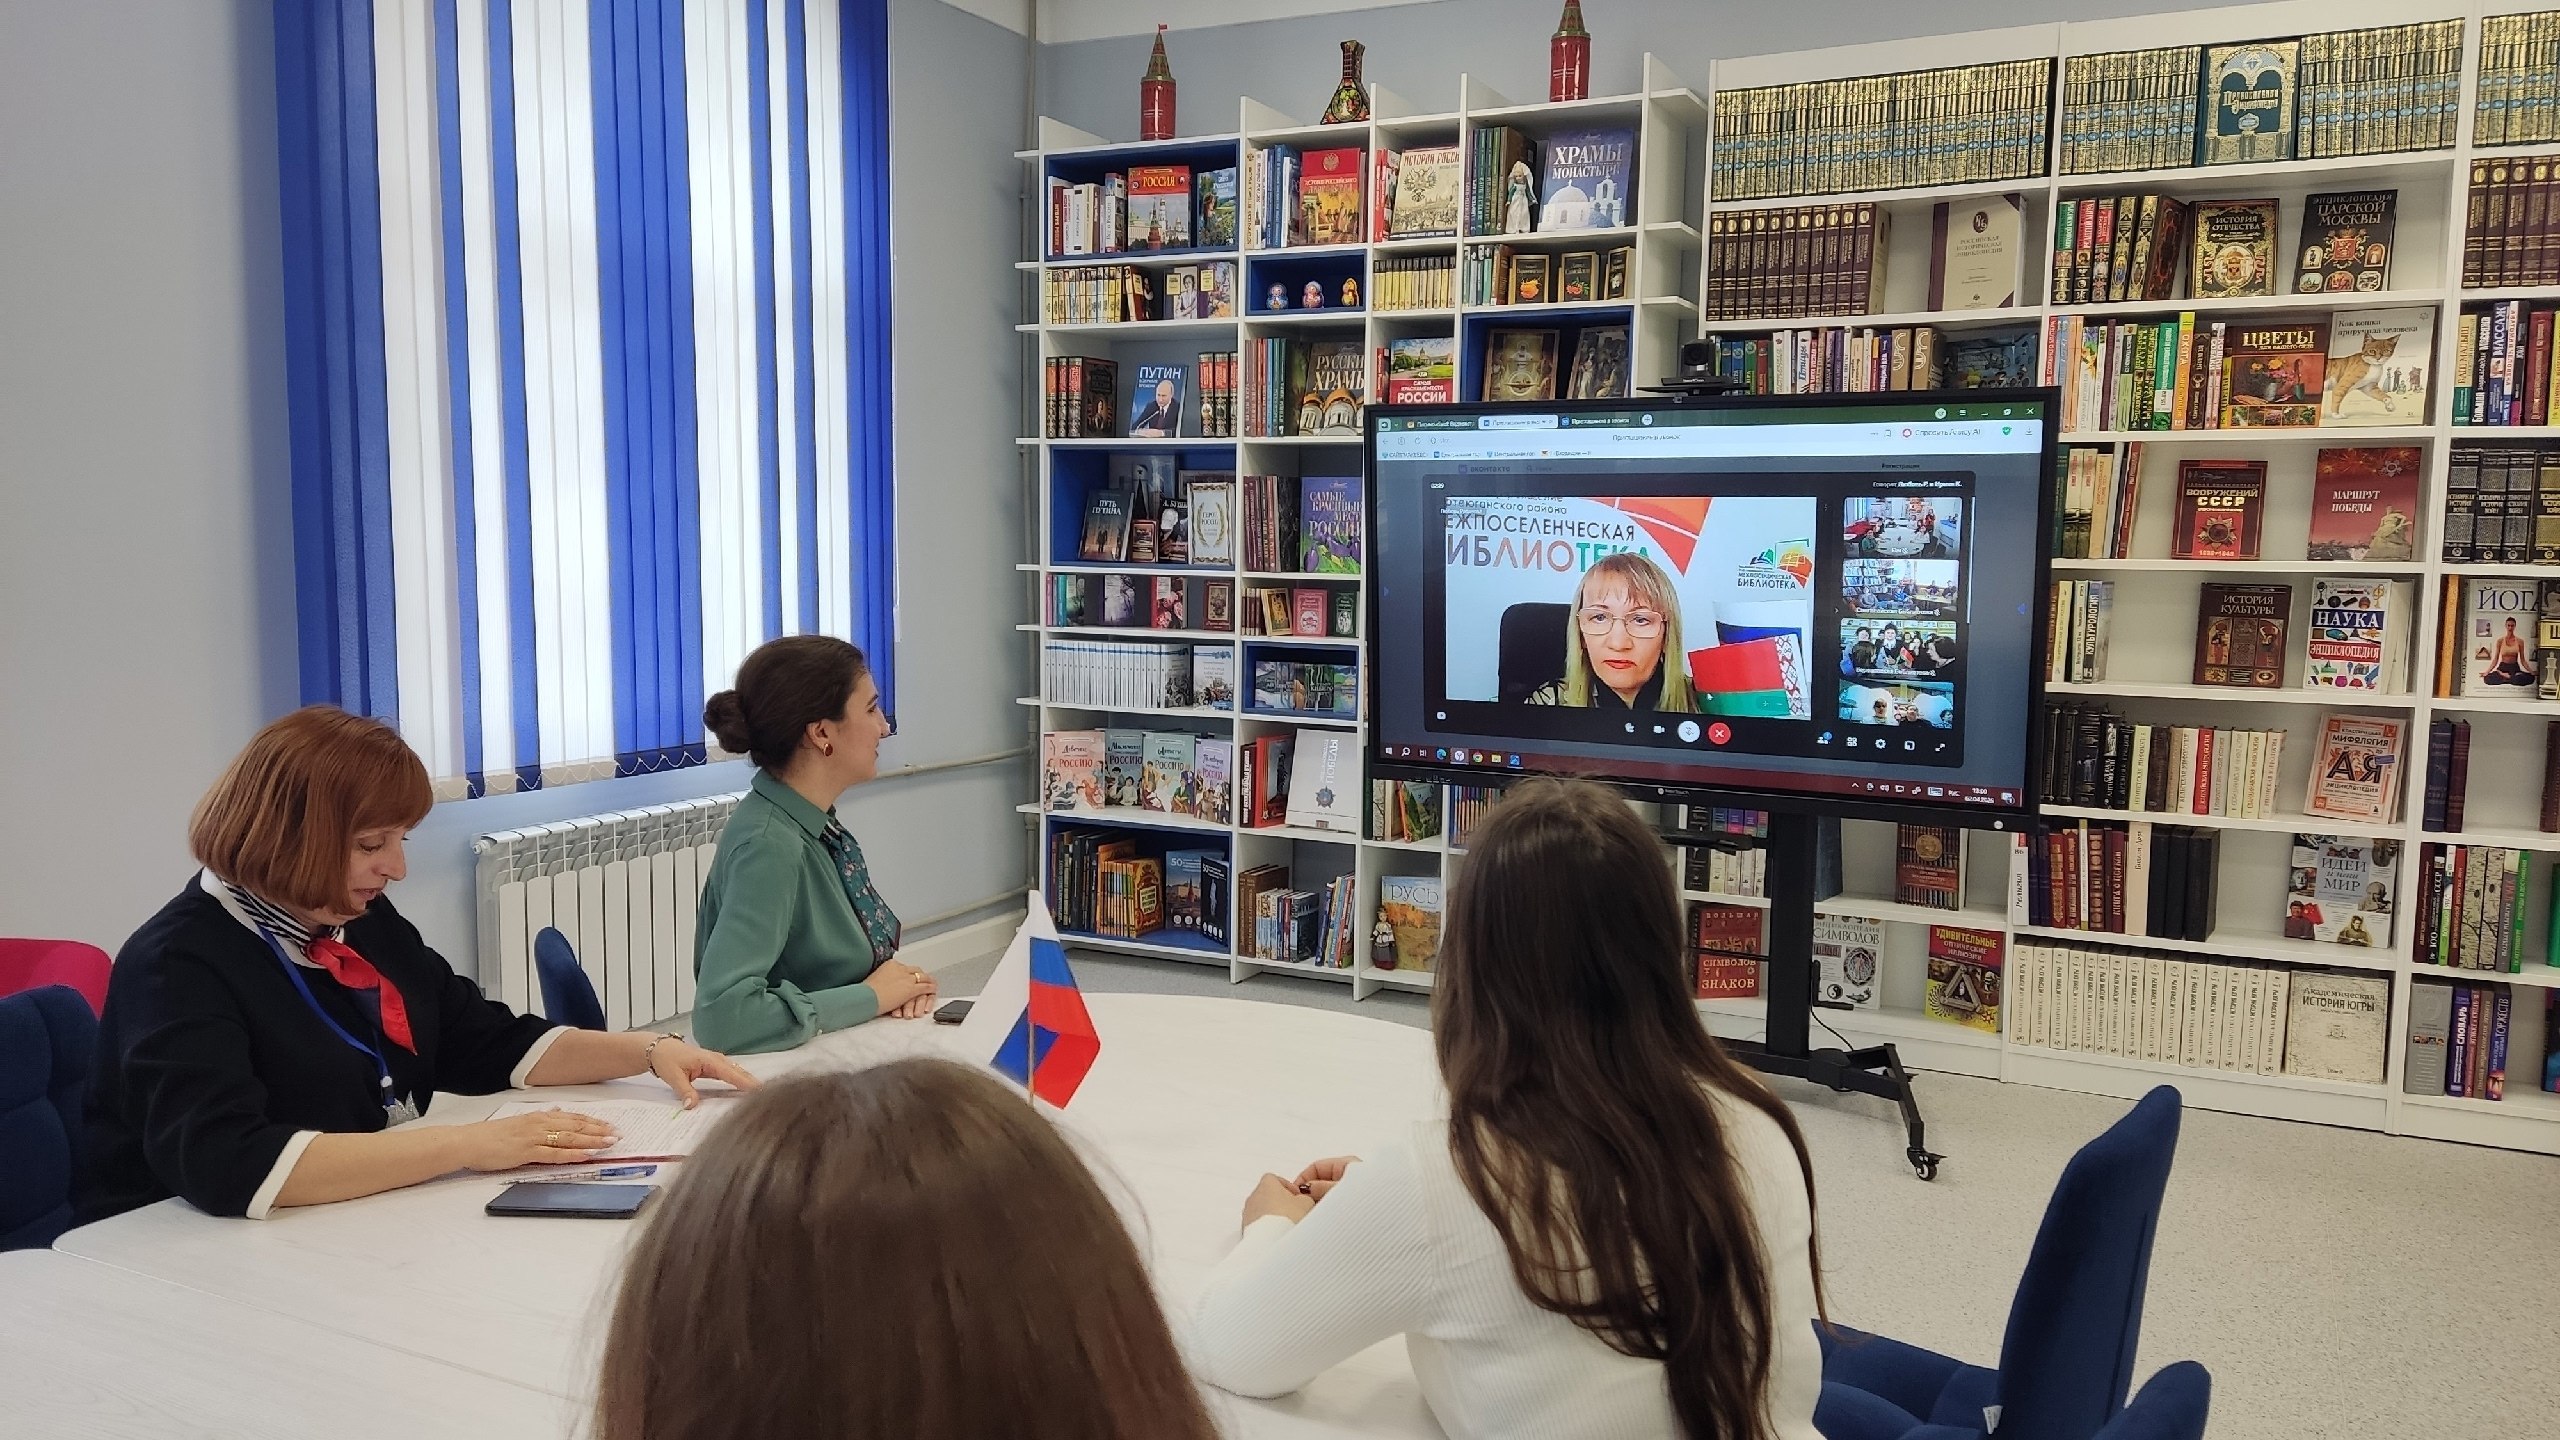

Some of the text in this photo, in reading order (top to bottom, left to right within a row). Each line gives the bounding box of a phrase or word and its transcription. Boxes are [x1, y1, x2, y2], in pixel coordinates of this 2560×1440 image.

[1403, 153, 1434, 166] ИСТОРИЯ
[1555, 143, 1623, 165] ХРАМЫ
[1552, 164, 1620, 179] МОНАСТЫРИ
[1142, 176, 1176, 187] РОССИЯ
[2317, 202, 2386, 215] ЦАРСКОЙ
[2216, 216, 2258, 224] ИСТОРИЯ
[2317, 214, 2381, 226] МОСКВЫ
[2212, 223, 2260, 231] ОТЕЧЕСТВА
[2492, 306, 2507, 356] МАССАЖ
[2242, 330, 2315, 348] ЦВЕТЫ
[2179, 334, 2189, 365] ОХОТА
[1139, 366, 1182, 379] ПУТИН
[1397, 391, 1447, 403] РОССИИ
[1309, 490, 1346, 501] САМЫЕ
[2186, 489, 2258, 497] ВООРУЖЕНИЙ
[2333, 490, 2380, 500] МАРШРУТ
[2197, 496, 2246, 507] СССР
[1527, 504, 1568, 515] района
[2332, 503, 2373, 514] ПОБЕДЫ
[1737, 579, 1797, 589] БИБЛИОТЕКА
[2223, 595, 2274, 605] ИСТОРИЯ
[2220, 604, 2275, 615] КУЛЬТУРЫ
[2085, 594, 2100, 655] КУЛЬТУРОЛОГИЯ
[2316, 610, 2380, 628] НАУКА
[2309, 643, 2380, 660] ЭНЦИКЛОПЕДИЯ
[2332, 734, 2389, 747] МИФОЛОГИЯ
[1059, 759, 1093, 768] РОССИЮ
[1109, 755, 1143, 765] РОССИЮ
[1155, 760, 1184, 771] РОССИЮ
[2326, 750, 2356, 781] А
[1170, 857, 1183, 867] 50
[2321, 857, 2367, 873] ИДЕИ
[2323, 878, 2361, 892] МИР
[1389, 884, 1439, 905] РУСЬ
[1706, 912, 1760, 920] БОЛЬШАЯ
[2429, 871, 2443, 949] 100 СССР
[1813, 928, 1880, 945] СИМВОЛОВ
[1936, 927, 1998, 949] УДИВИТЕЛЬНЫЕ
[1703, 959, 1757, 967] СИМВОЛОВ
[1702, 979, 1755, 989] ЗНАКОВ
[2303, 987, 2376, 1001] Академическая
[2302, 996, 2375, 1013] ИСТОРИЯ ЮГРЫ
[2495, 998, 2509, 1037] ТОРЖЕСТВ
[2456, 1006, 2468, 1045] СЛОВАРЬ
